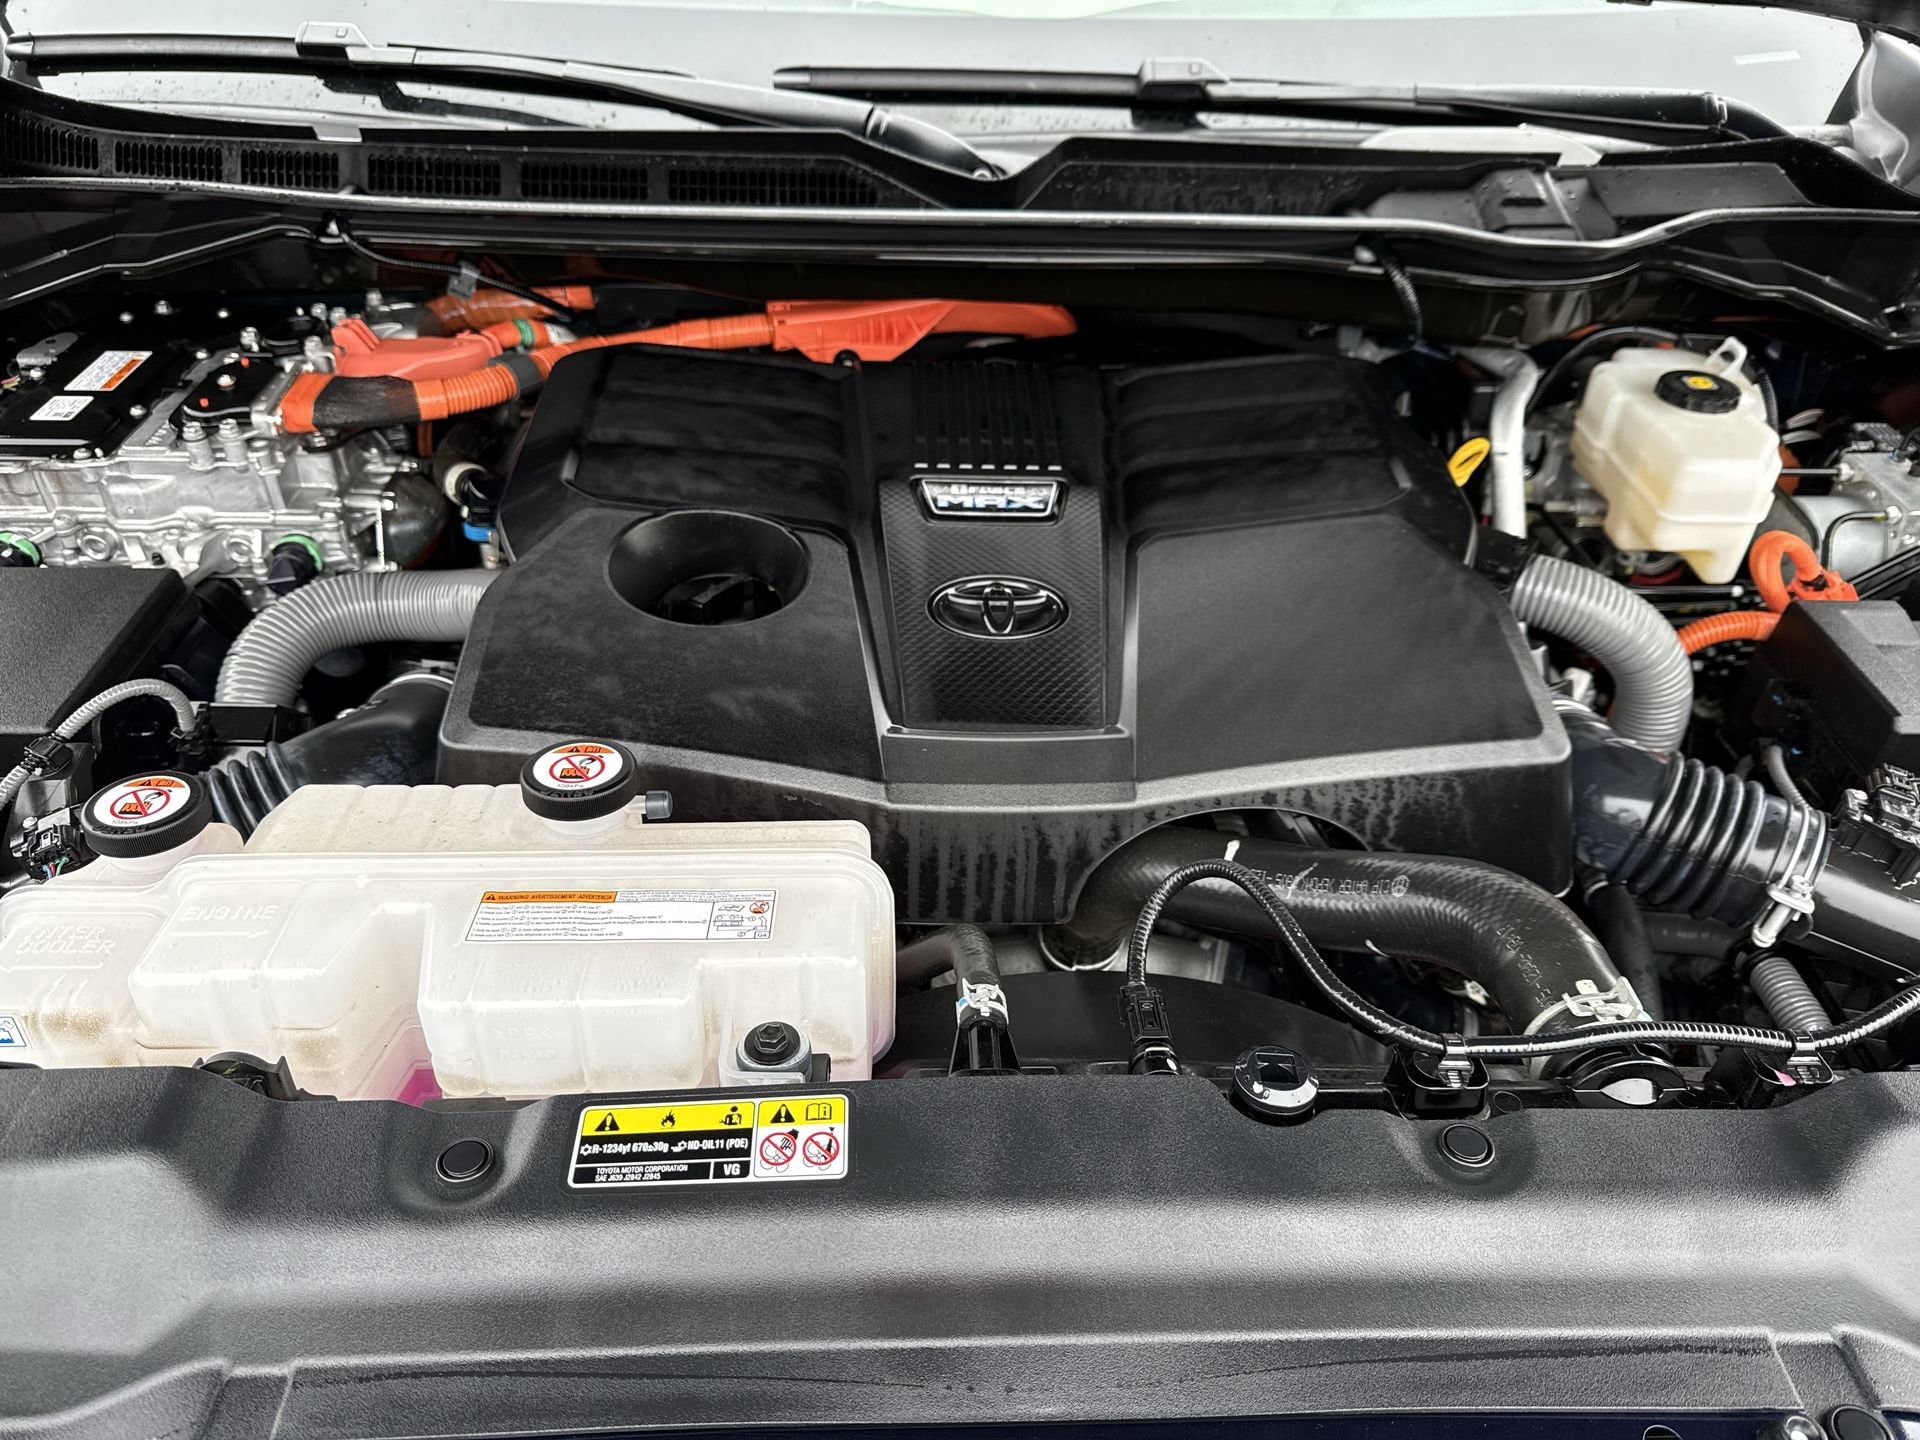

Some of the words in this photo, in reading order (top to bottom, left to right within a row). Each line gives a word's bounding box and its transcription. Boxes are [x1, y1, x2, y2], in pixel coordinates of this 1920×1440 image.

[936, 495, 1046, 509] MAX
[578, 893, 613, 901] ADVERTENCIA
[178, 904, 280, 922] ENGINE
[24, 926, 106, 940] INTER
[15, 938, 117, 955] COOLER
[726, 1138, 749, 1150] (POE)
[596, 1167, 620, 1175] TOYOTA
[621, 1166, 644, 1174] MOTOR
[645, 1165, 689, 1173] CORPORATION
[723, 1164, 741, 1176] VG
[595, 1174, 607, 1182] SAE
[608, 1174, 623, 1182] J639
